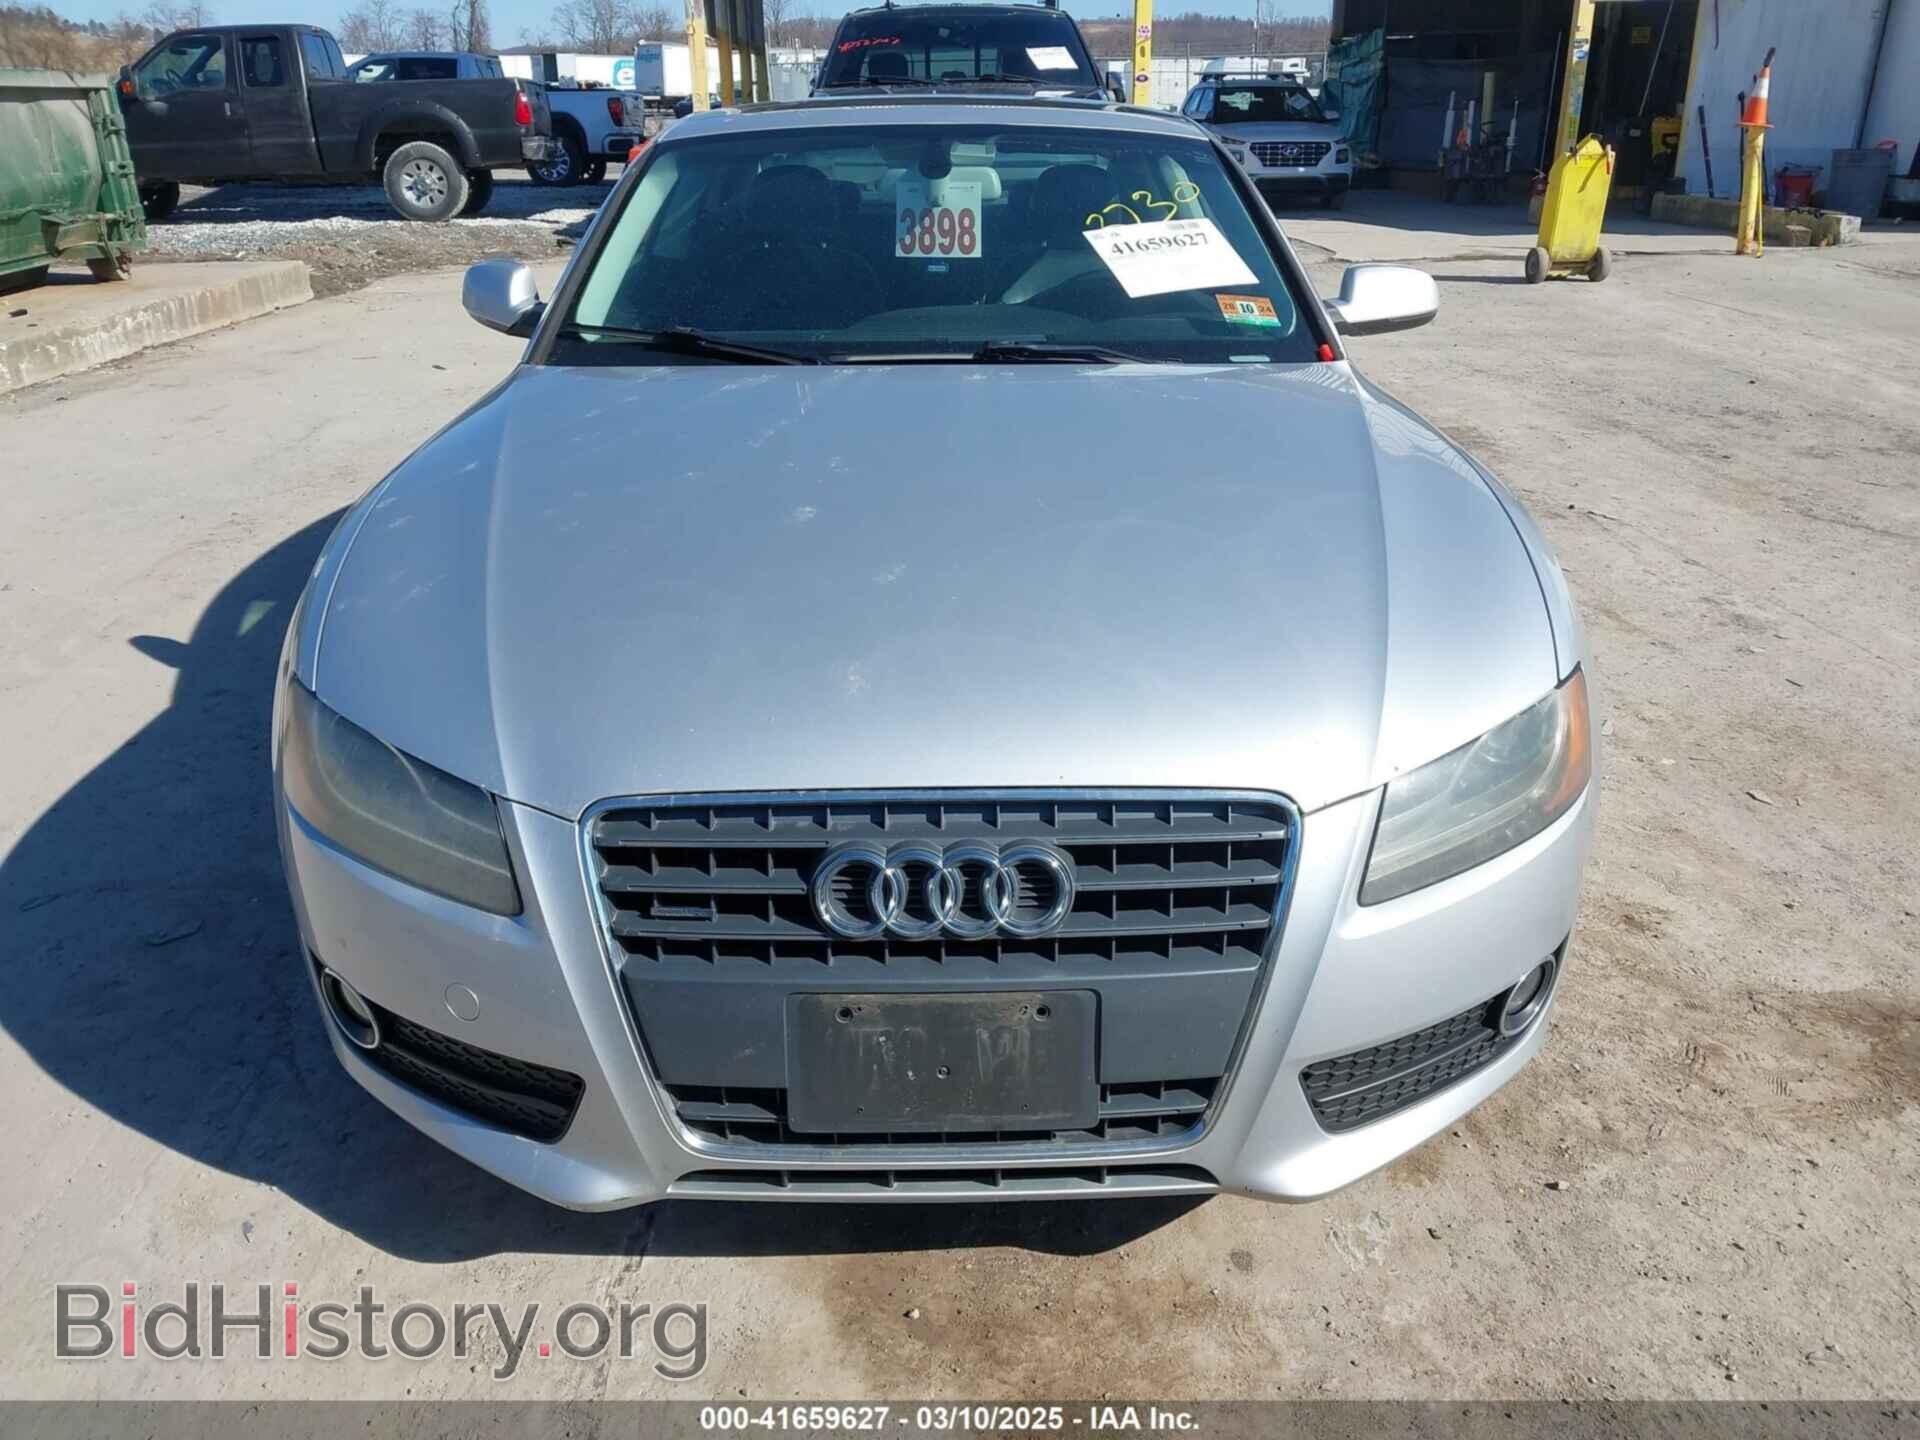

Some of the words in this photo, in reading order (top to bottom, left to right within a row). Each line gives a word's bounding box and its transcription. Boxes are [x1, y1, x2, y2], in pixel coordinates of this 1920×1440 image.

[898, 207, 977, 255] 3898
[1111, 231, 1209, 256] 41659627
[1239, 302, 1255, 314] 10
